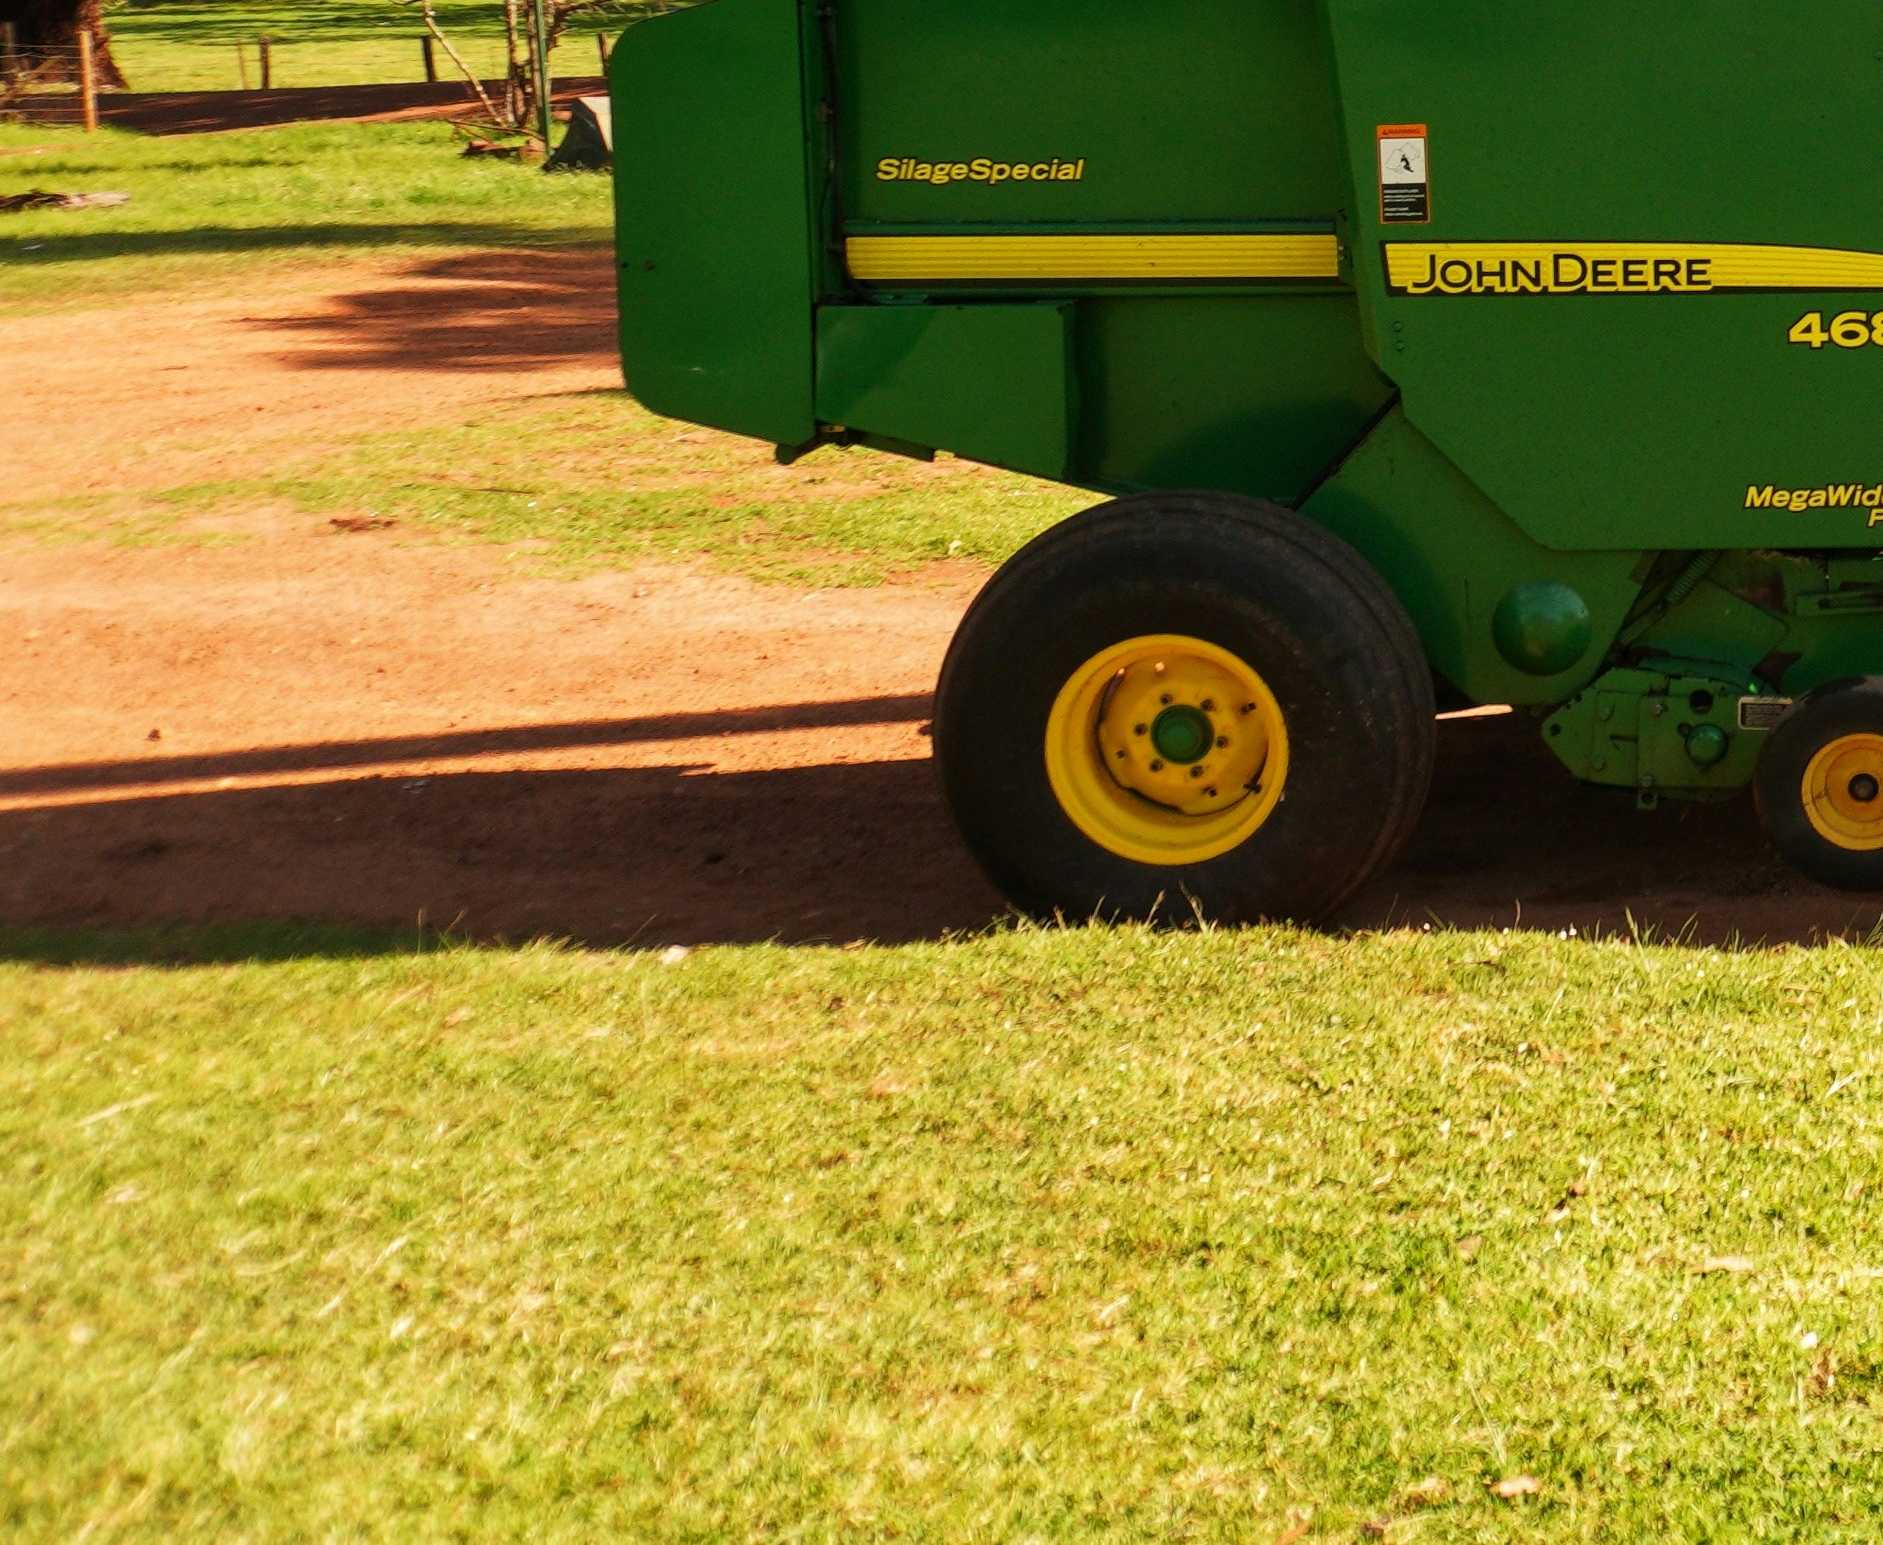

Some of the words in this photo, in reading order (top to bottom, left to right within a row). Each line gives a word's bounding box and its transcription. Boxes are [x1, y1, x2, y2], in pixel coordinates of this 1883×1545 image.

[875, 157, 1086, 186] SilageSpecial
[1412, 253, 1542, 289] JOHN
[1552, 253, 1713, 287] DEERE
